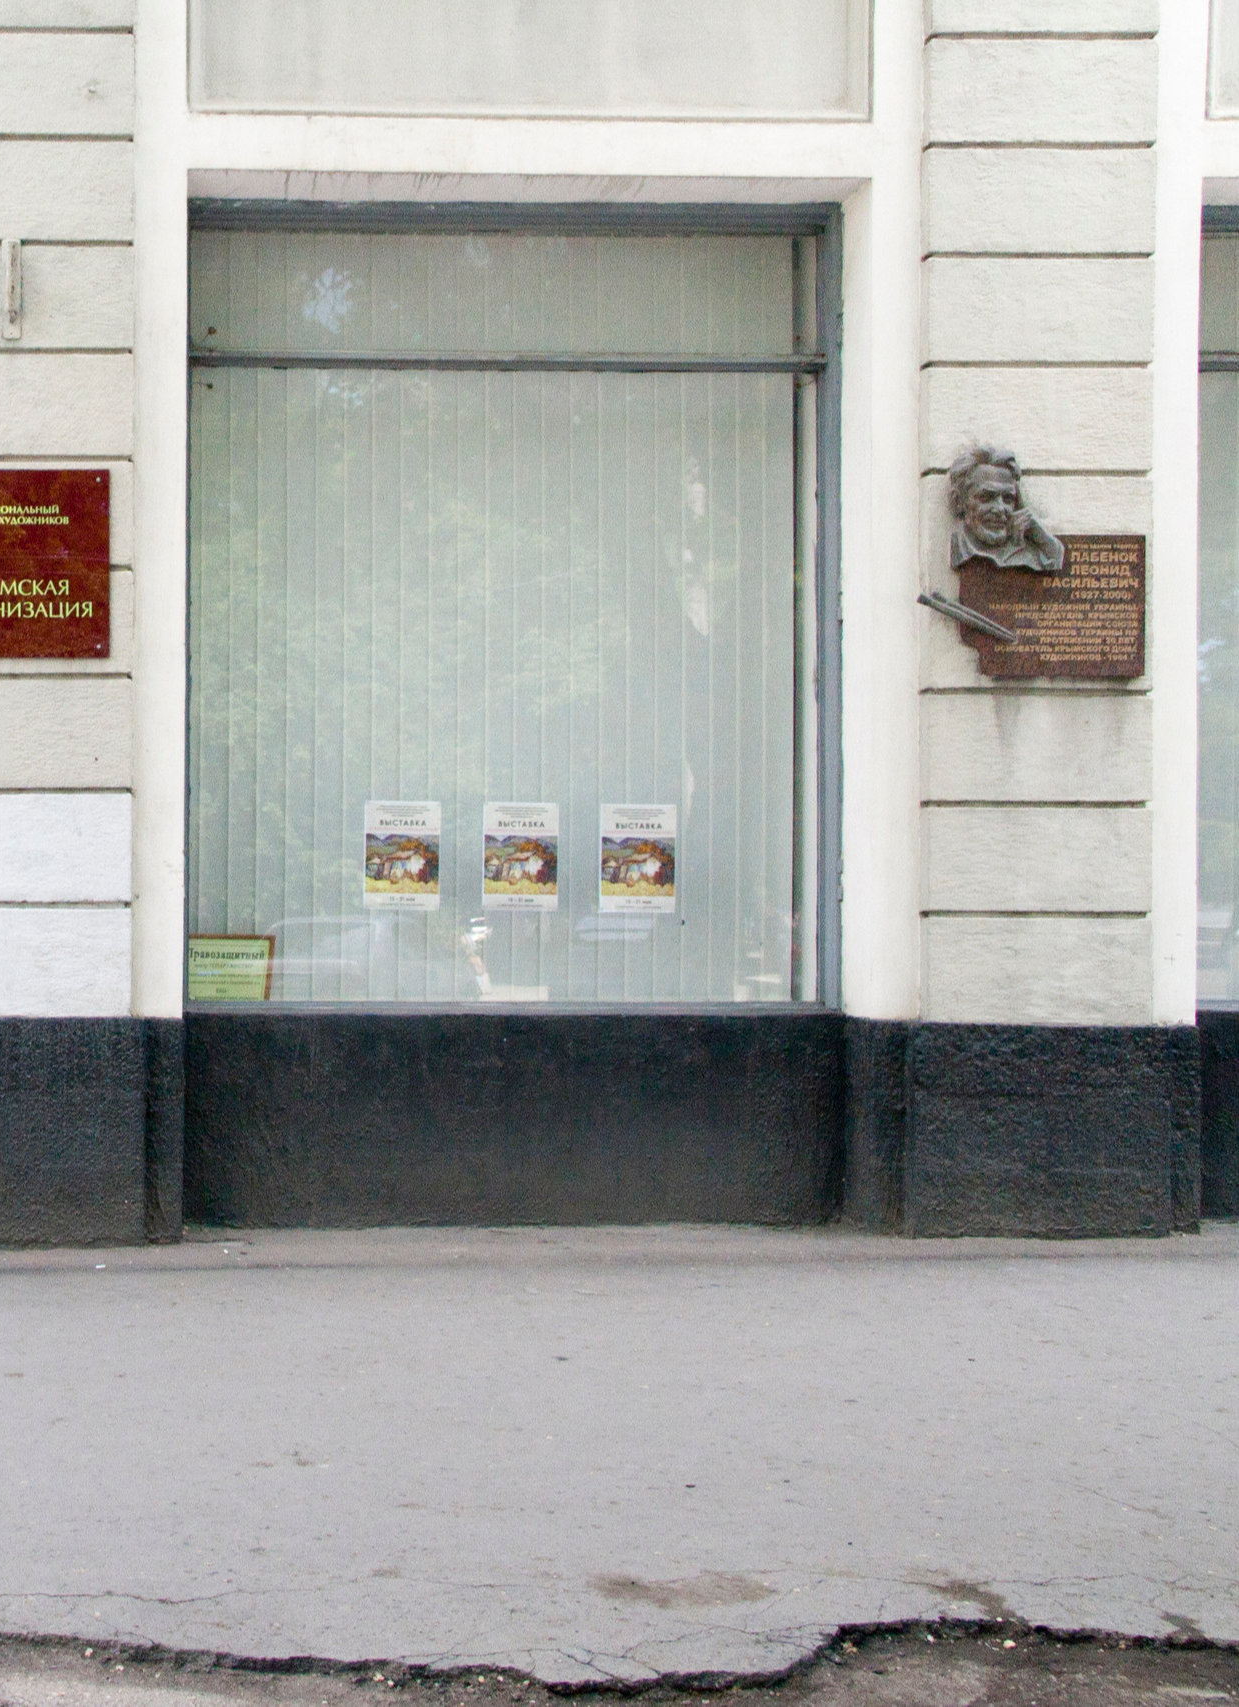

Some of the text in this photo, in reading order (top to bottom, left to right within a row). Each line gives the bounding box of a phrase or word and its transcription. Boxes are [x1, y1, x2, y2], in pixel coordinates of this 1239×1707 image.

[1070, 565, 1131, 577] ЛЕОНИД
[1042, 577, 1139, 588] ВАСИЛЬЕВИЧ
[498, 820, 545, 828] ВЫСТАВКА
